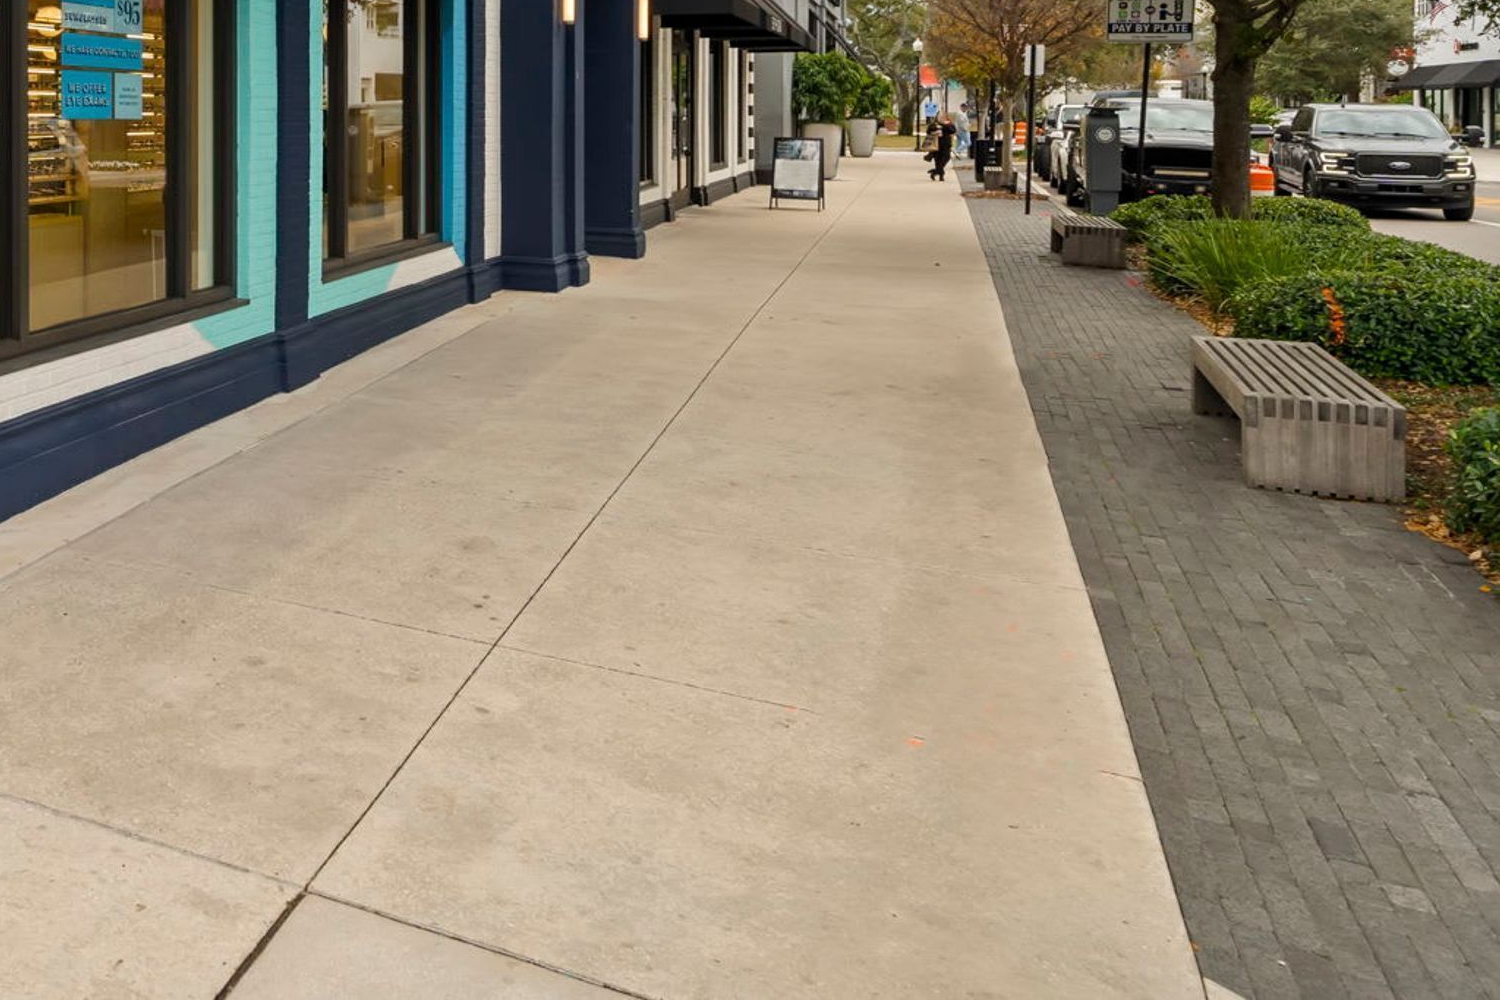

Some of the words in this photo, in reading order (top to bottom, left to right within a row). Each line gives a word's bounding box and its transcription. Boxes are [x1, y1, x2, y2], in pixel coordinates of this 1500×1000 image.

[117, 0, 141, 26] $95
[1111, 23, 1132, 33] PAY
[1135, 23, 1150, 33] BY
[1153, 23, 1189, 33] PLATE
